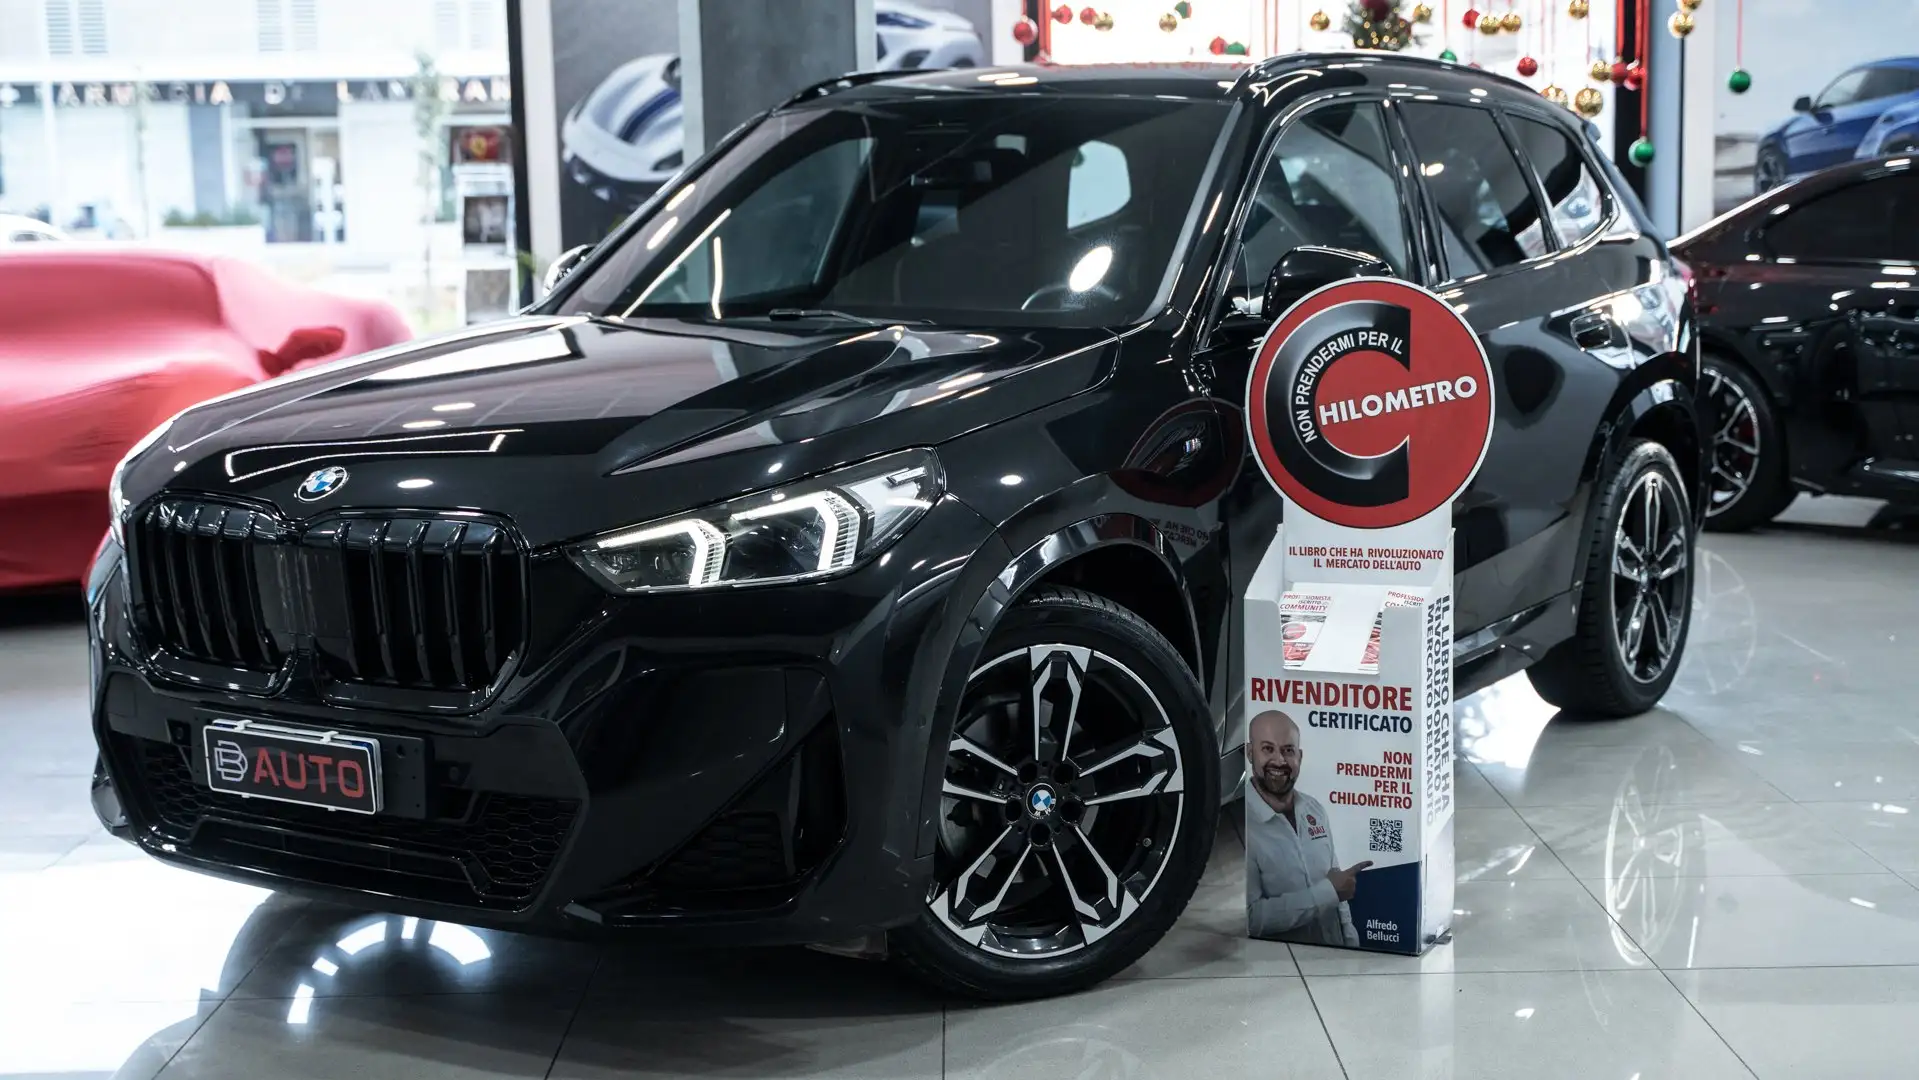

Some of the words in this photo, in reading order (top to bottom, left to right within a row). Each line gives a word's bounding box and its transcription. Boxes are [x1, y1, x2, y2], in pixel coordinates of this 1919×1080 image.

[1358, 331, 1389, 348] PER
[1390, 337, 1403, 355] IL
[1296, 333, 1355, 405] PRENDERMI
[1318, 375, 1477, 426] HILOMETRO
[1296, 409, 1318, 443] NON
[1289, 546, 1298, 556] IL
[1299, 546, 1327, 557] LIBRO
[1329, 547, 1348, 557] CHE
[1350, 548, 1363, 558] HA
[1368, 548, 1444, 560] RIVOLUZIONATO
[1313, 558, 1322, 568] IL
[1326, 559, 1370, 570] MERCATO
[1372, 560, 1421, 571] DELL'AUTO
[1280, 603, 1327, 611] COMMUNITY
[1442, 595, 1450, 620] IL
[1426, 603, 1435, 708] MERCATO
[1441, 624, 1450, 705] LIBRO
[1251, 677, 1412, 711] RIVENDITORE
[1433, 598, 1442, 792] RIVOLUZIONATO
[1308, 710, 1412, 733] CERTIFICATO
[1441, 712, 1450, 767] CHE
[1383, 751, 1412, 765] NON
[253, 748, 365, 798] AUTO
[1336, 763, 1412, 780] PRENDERMI
[1374, 780, 1399, 794] PER
[1401, 782, 1413, 795] IL
[1441, 771, 1450, 812] HA
[1329, 791, 1412, 809] CHILOMETRO
[1366, 919, 1397, 931] Alfredo
[1366, 930, 1399, 943] Bellucci
